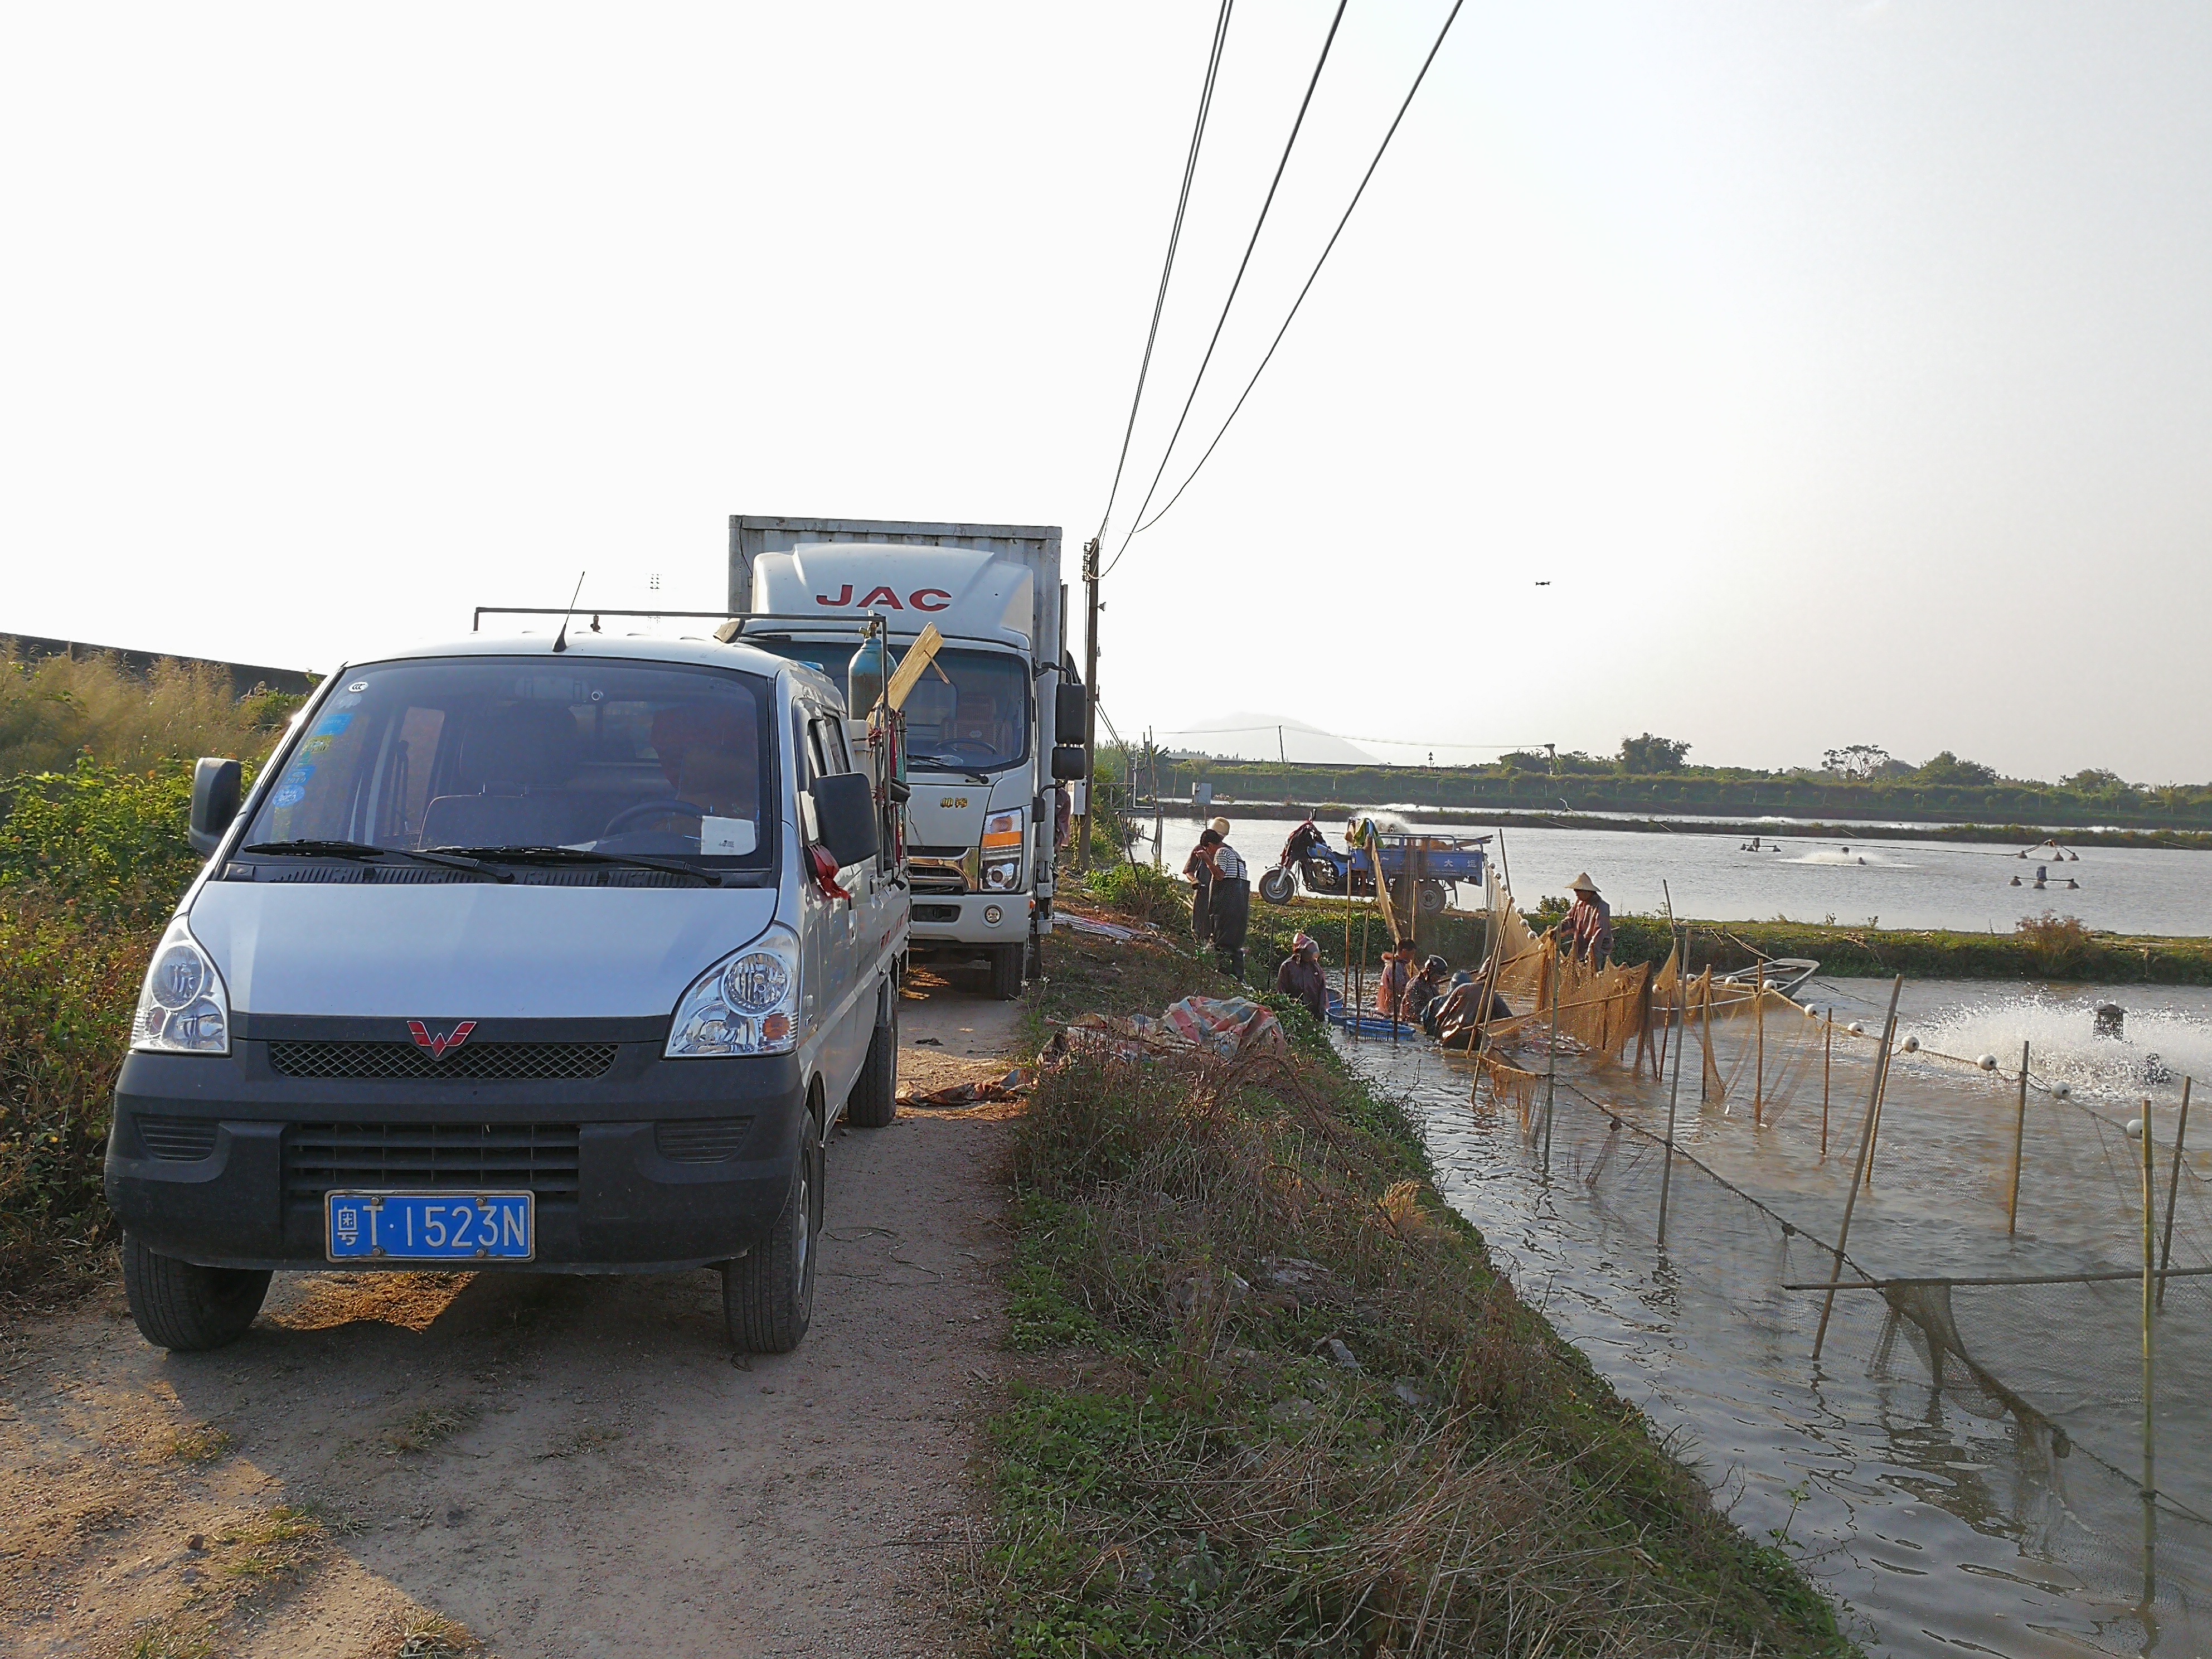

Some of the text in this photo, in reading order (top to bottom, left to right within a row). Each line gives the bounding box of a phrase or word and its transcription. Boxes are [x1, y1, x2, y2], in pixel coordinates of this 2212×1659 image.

[816, 584, 952, 612] JAC
[1444, 859, 1477, 867] 大运
[337, 1205, 525, 1247] 粤T·1523N
